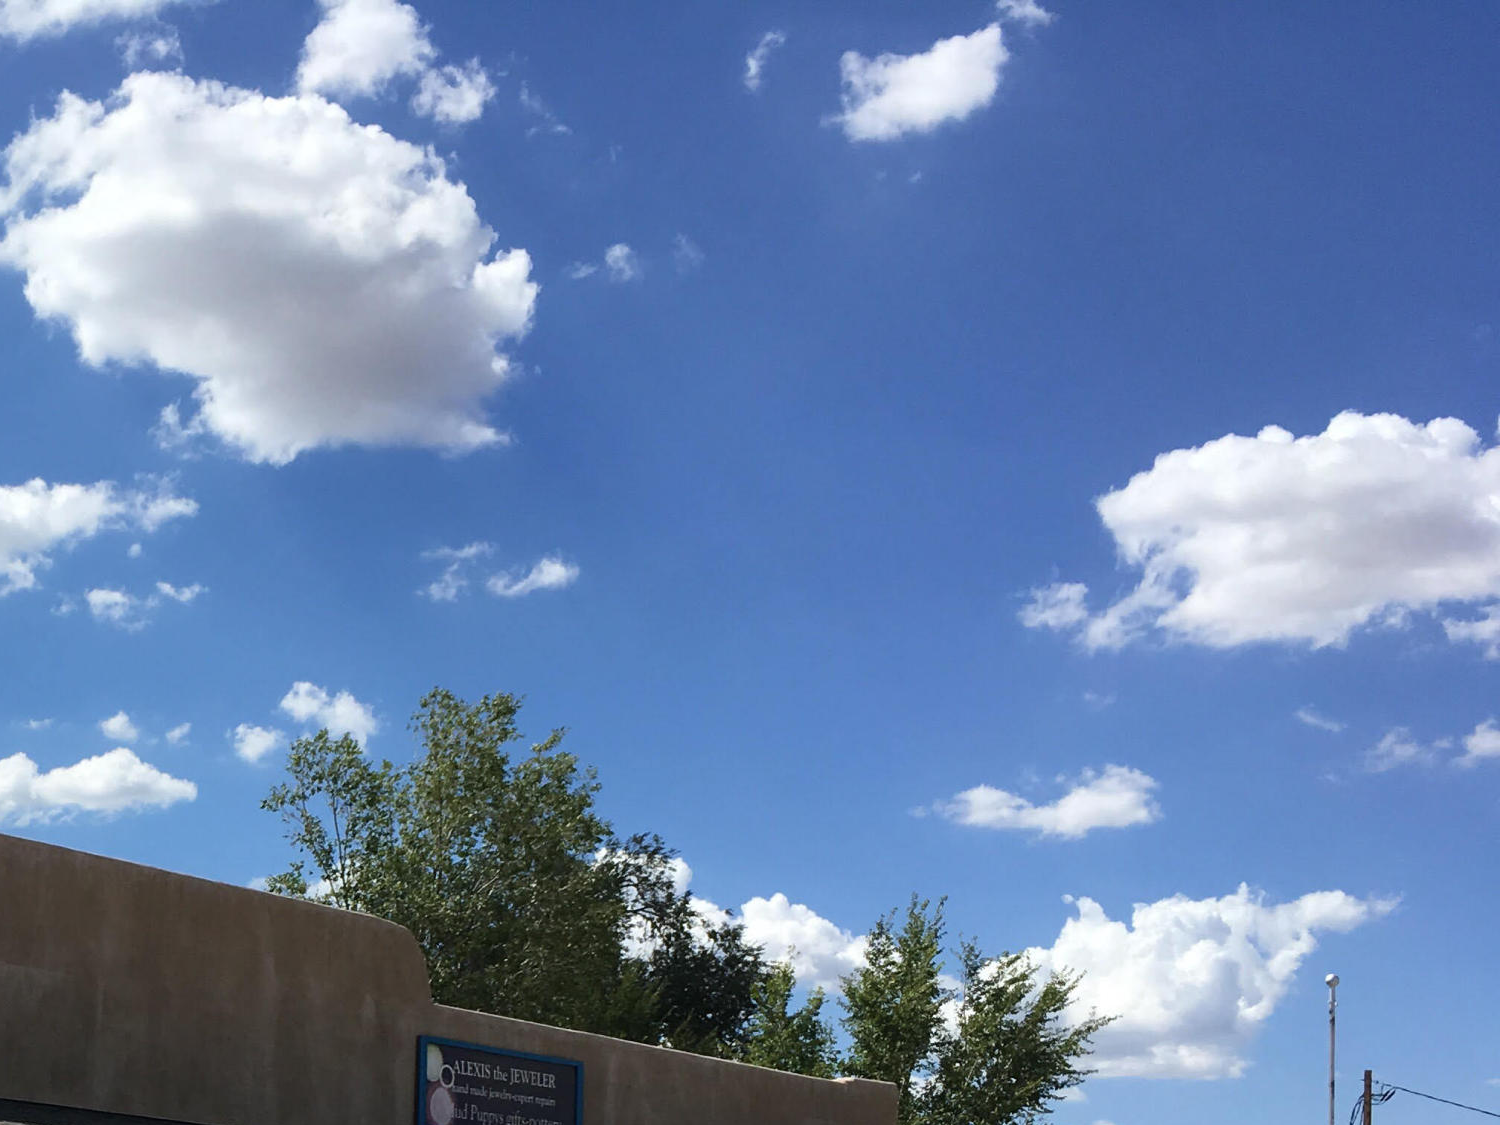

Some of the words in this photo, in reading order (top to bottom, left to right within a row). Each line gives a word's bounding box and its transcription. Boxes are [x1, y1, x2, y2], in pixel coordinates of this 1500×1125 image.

[452, 1059, 491, 1079] ALEXIS
[493, 1065, 508, 1081] the
[509, 1067, 557, 1089] JEWELER
